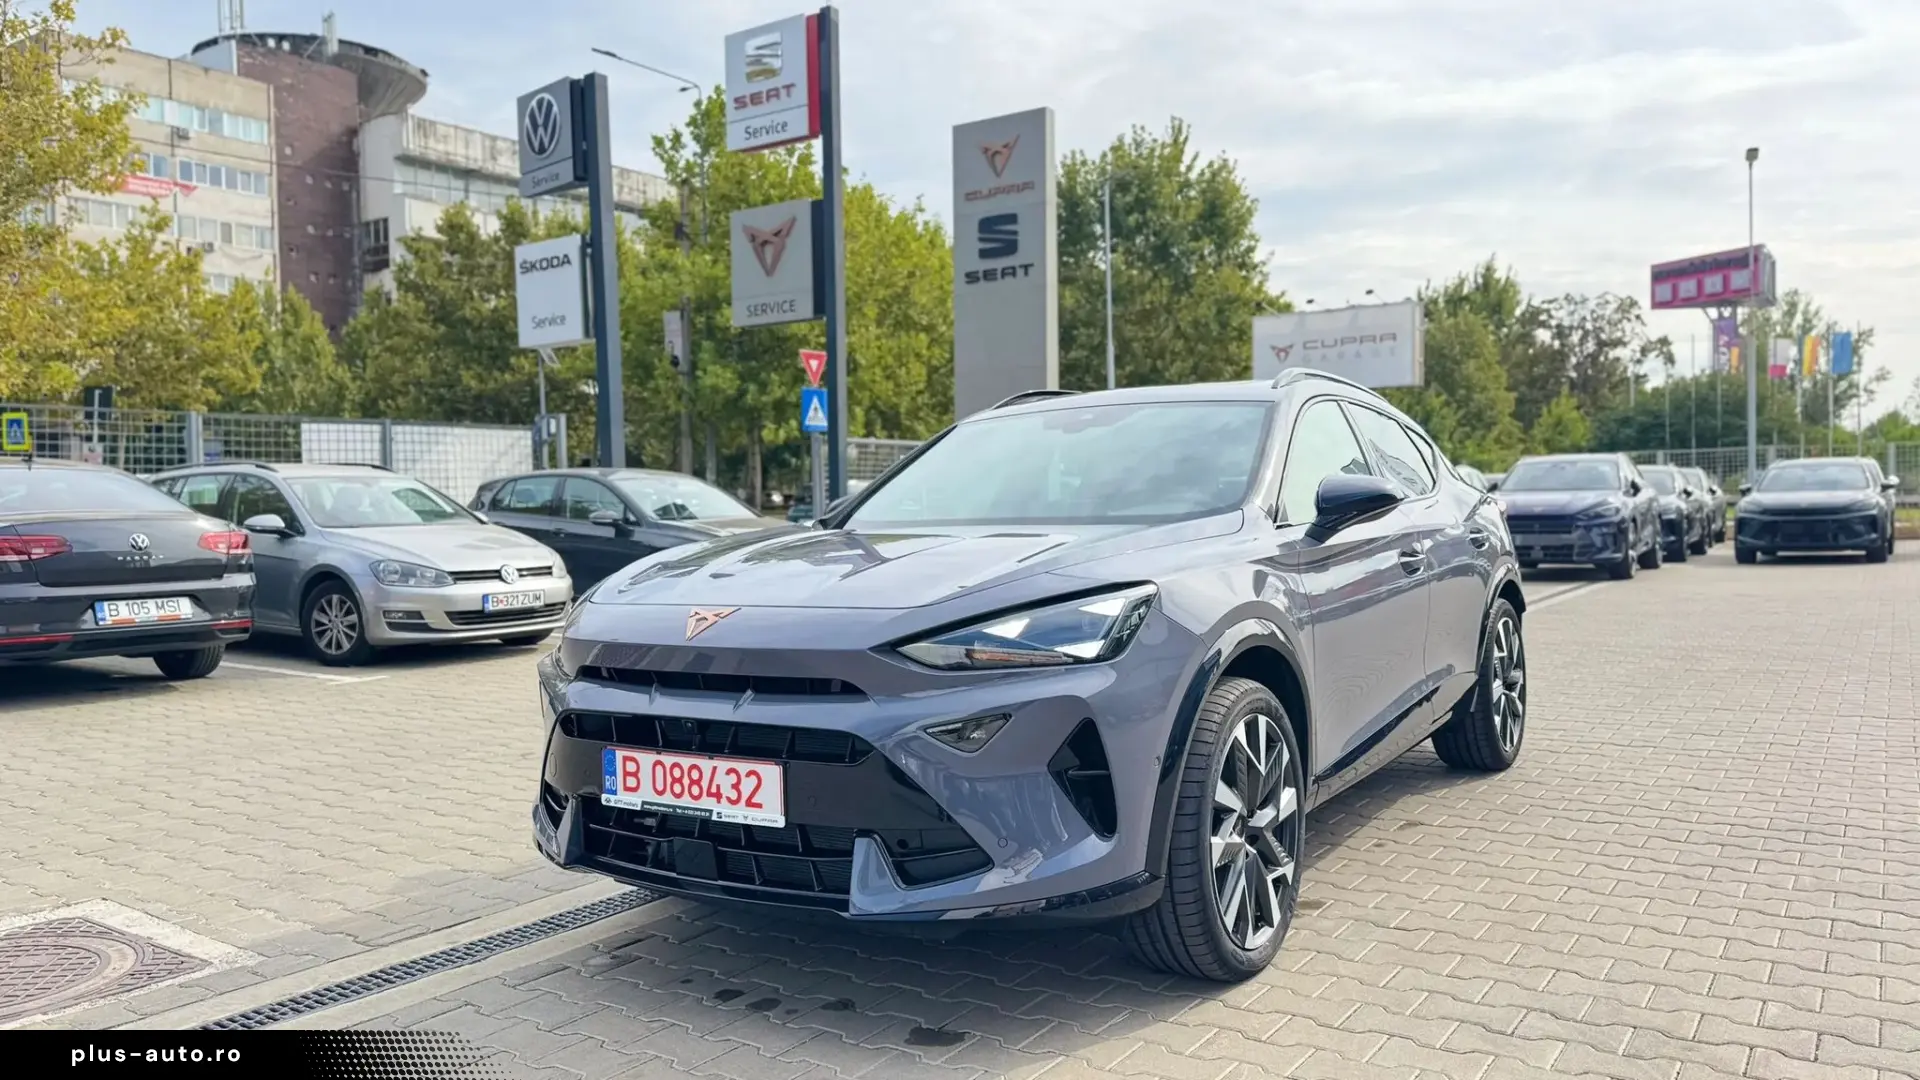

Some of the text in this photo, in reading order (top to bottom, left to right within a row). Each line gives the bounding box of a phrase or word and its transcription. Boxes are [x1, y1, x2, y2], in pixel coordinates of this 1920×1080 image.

[733, 82, 796, 111] SEAT
[744, 119, 788, 141] Service
[531, 171, 560, 189] Service
[964, 180, 1035, 202] CUPRA
[519, 252, 572, 275] ŠKODA
[964, 262, 1035, 285] SEAT
[746, 298, 796, 318] SERVICE
[531, 312, 566, 330] Service
[1302, 332, 1397, 351] CUPRA
[108, 599, 181, 617] B 105 MSI
[491, 592, 542, 608] B 321 ZUM
[604, 775, 617, 790] RO
[622, 755, 763, 809] B 088432
